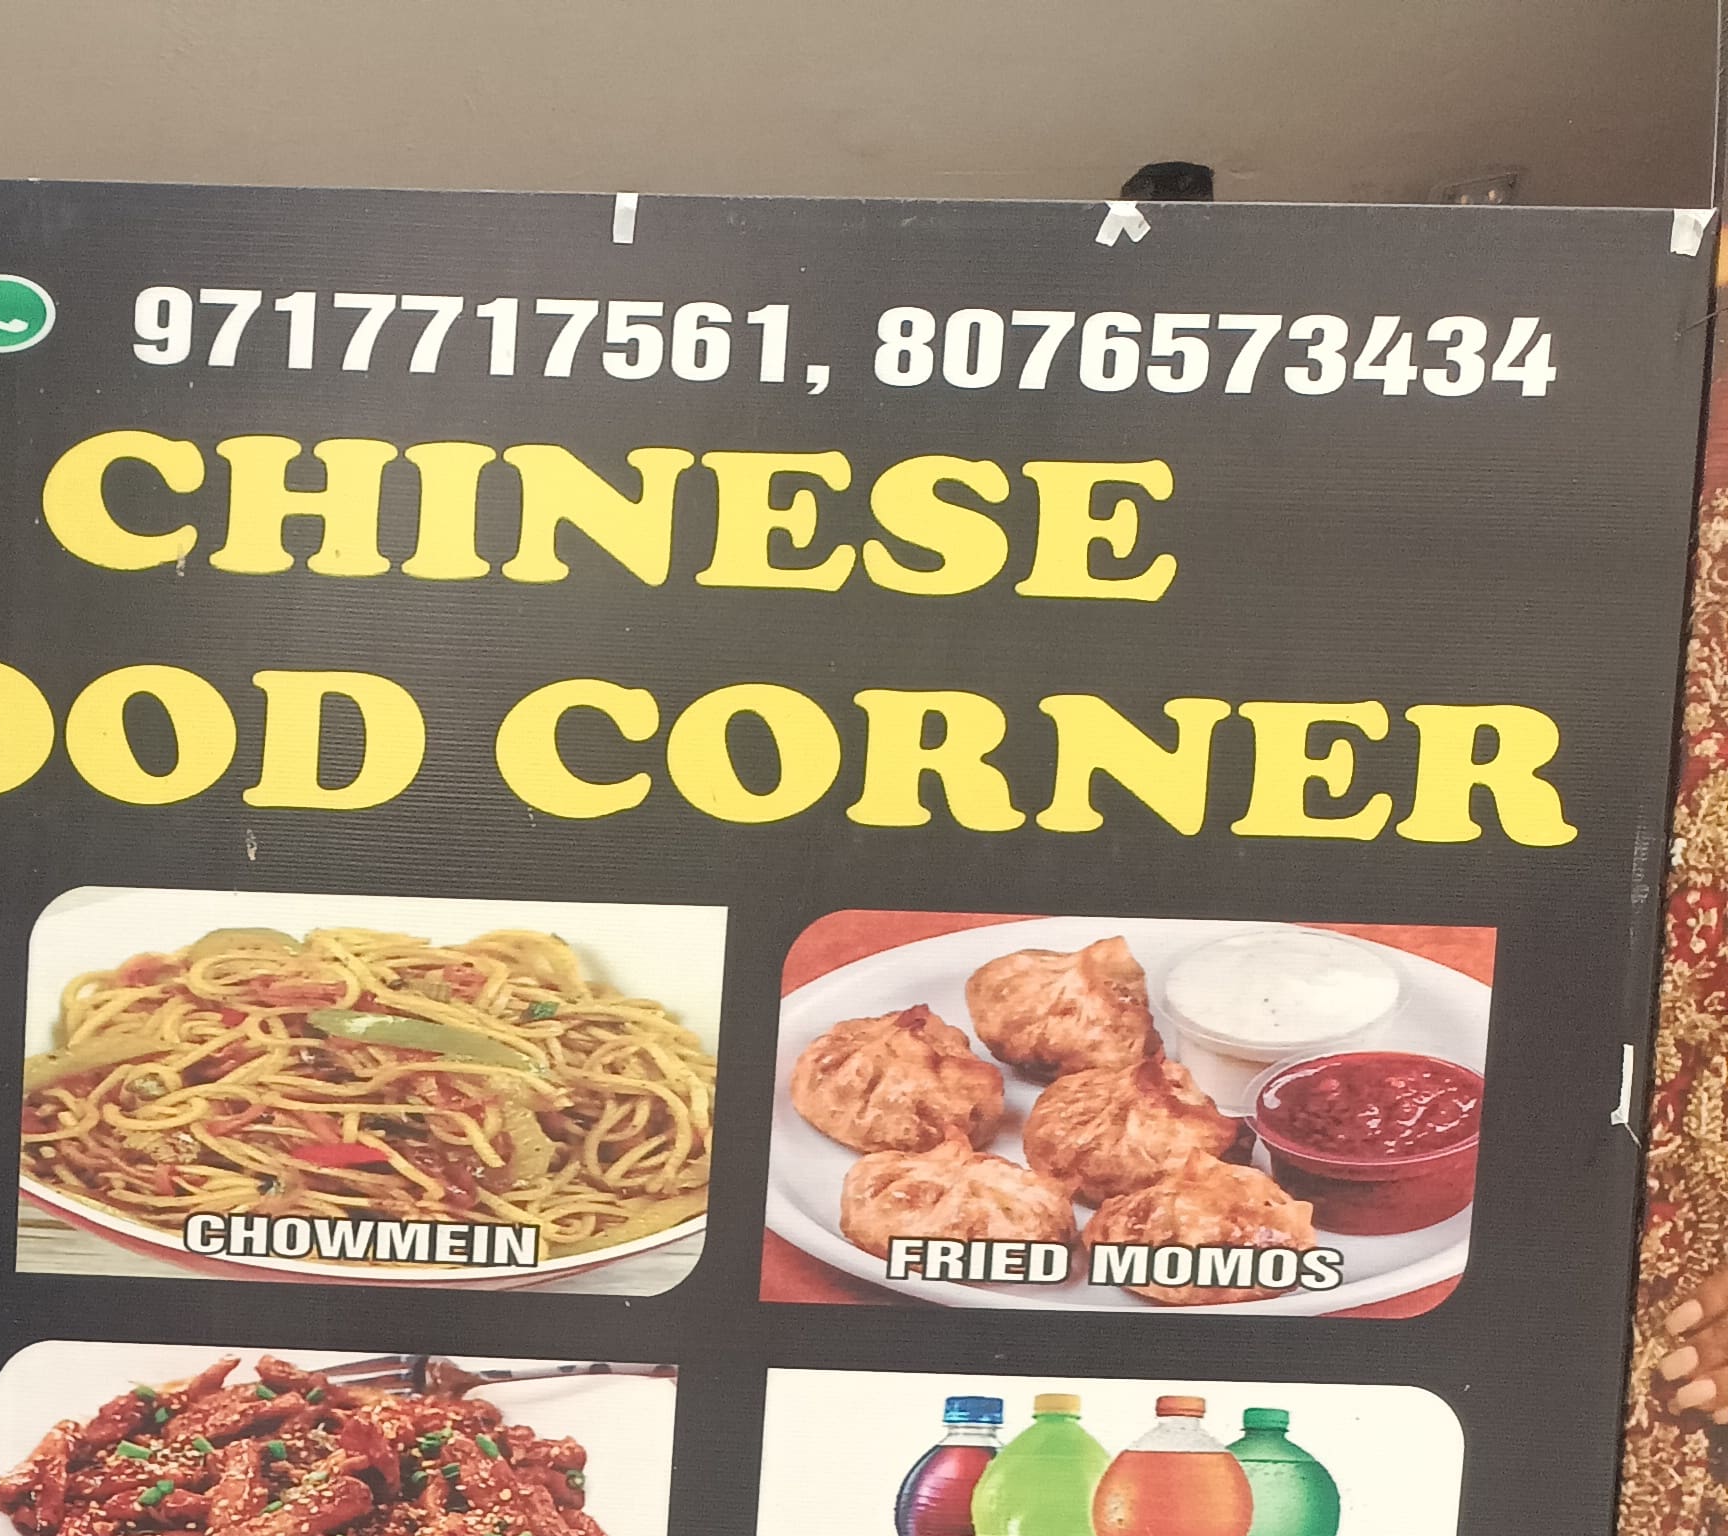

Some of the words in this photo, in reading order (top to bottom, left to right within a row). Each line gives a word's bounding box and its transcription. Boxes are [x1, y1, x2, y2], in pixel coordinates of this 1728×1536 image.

[133, 286, 830, 395] 9717717561,
[874, 306, 1557, 397] 8076573434
[42, 430, 1178, 602] CHINESE
[494, 678, 1580, 847] CORNER
[182, 1212, 539, 1268] CHOWMEIN
[888, 1235, 1070, 1288] FRIED
[1088, 1240, 1344, 1293] MOMOS
